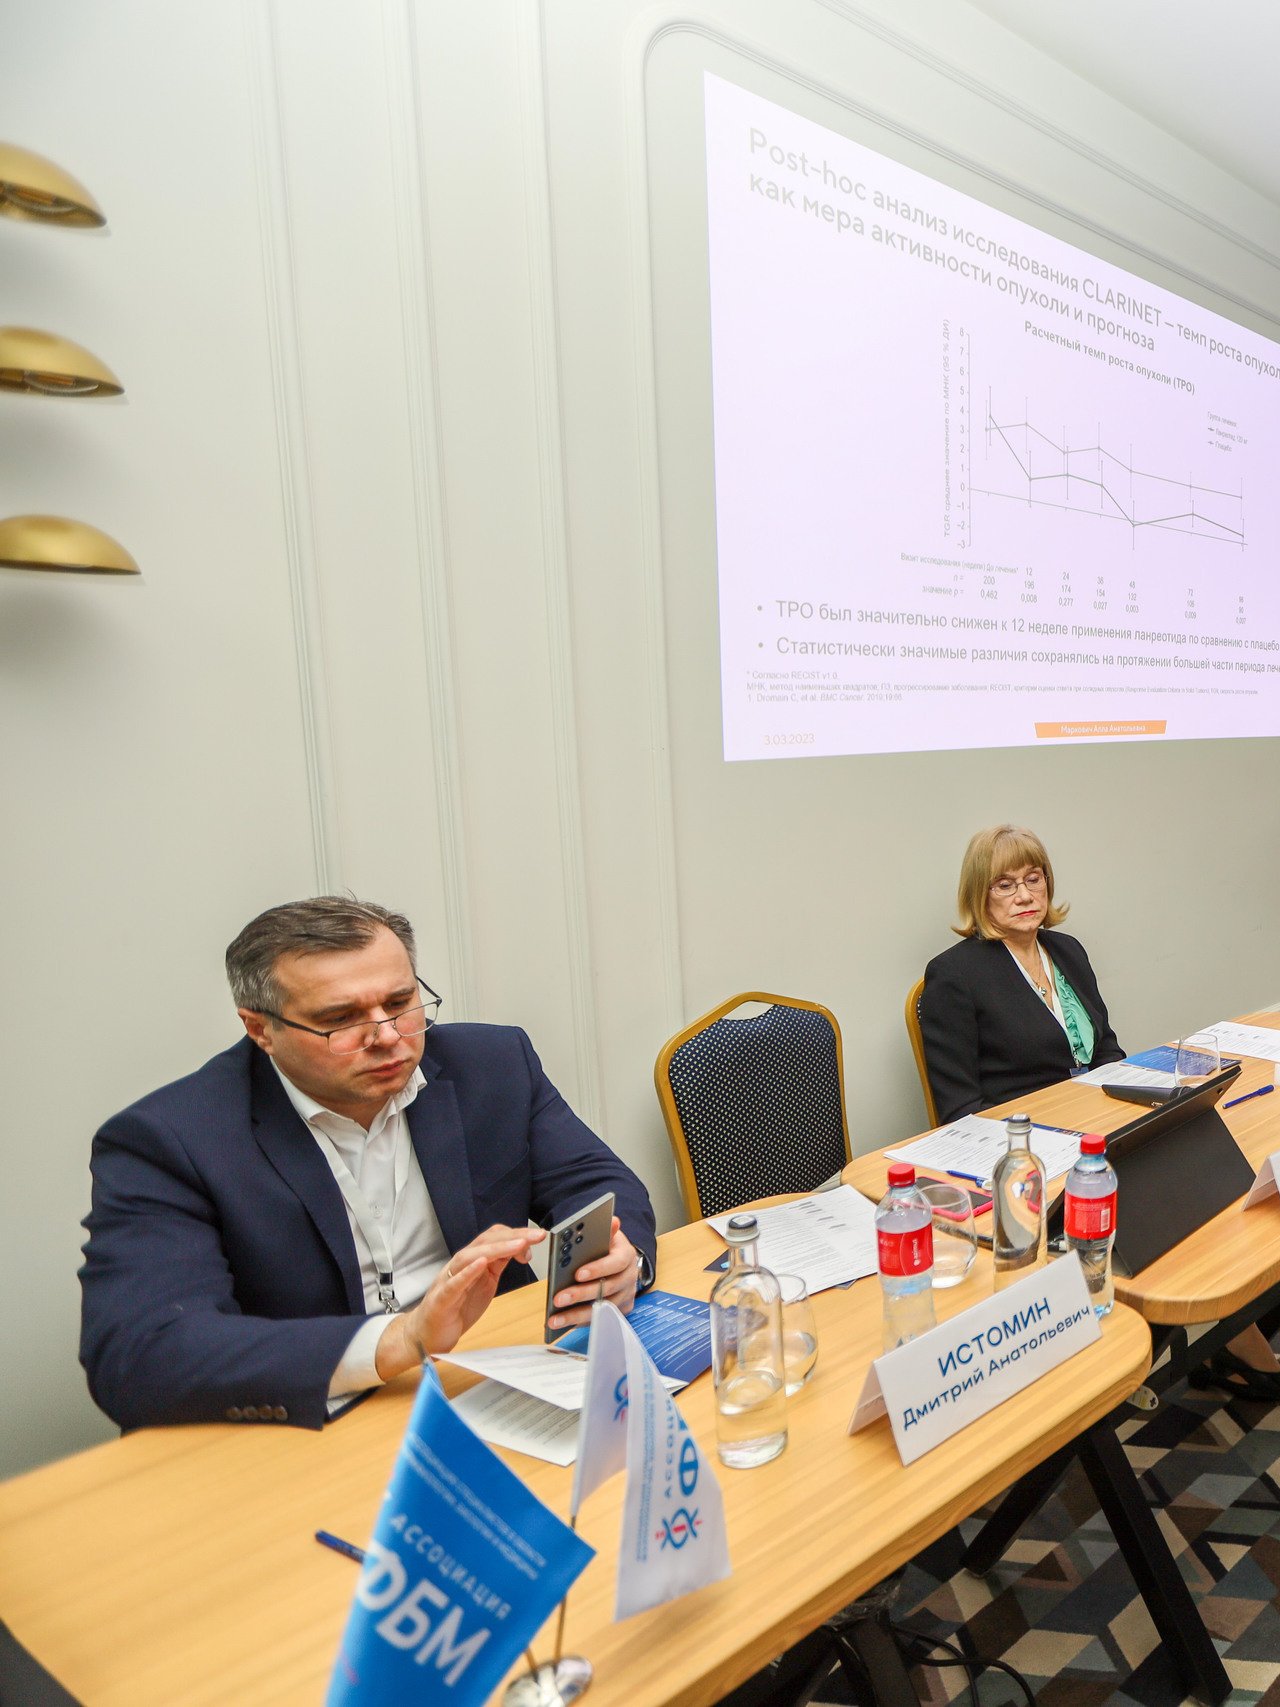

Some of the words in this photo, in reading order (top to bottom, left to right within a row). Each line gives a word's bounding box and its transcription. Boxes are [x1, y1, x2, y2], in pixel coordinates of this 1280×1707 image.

[749, 127, 867, 201] Post-hoc
[873, 190, 948, 236] анализ
[953, 224, 1078, 292] исследования
[1083, 278, 1162, 327] CLARINET
[1177, 323, 1207, 348] темп
[1209, 339, 1242, 363] роста
[750, 173, 795, 208] как
[803, 195, 865, 235] мера
[871, 224, 992, 286] активности
[997, 277, 1070, 318] опухоли
[1073, 306, 1083, 324] и
[1087, 312, 1155, 352] прогноза
[1024, 320, 1081, 352] Расчетный
[1083, 344, 1106, 361] темп
[1108, 354, 1134, 373] роста
[1136, 364, 1172, 386] опухоли
[1173, 376, 1196, 396] (ТРО)
[983, 576, 995, 585] 200
[1061, 585, 1071, 594] 174
[1026, 567, 1033, 577] 12
[1062, 572, 1070, 581] 24
[775, 600, 814, 620] ТРО
[819, 603, 852, 622] был
[857, 608, 948, 628] значительно
[951, 615, 998, 631] снижен
[1001, 619, 1008, 631] к
[1012, 618, 1025, 633] 12
[1028, 621, 1068, 636] неделе
[1071, 625, 1132, 640] применения
[1134, 630, 1187, 646] ланреотида
[1189, 634, 1199, 645] по
[1200, 635, 1243, 650] сравнению
[1244, 639, 1249, 649] с
[776, 636, 896, 658] Статистически
[899, 645, 968, 660] значимые
[971, 648, 1028, 663] различия
[1031, 650, 1100, 666] сохранялись
[1102, 654, 1114, 666] на
[1116, 655, 1171, 669] протяжении
[1173, 656, 1210, 670] большей
[1211, 660, 1234, 671] части
[1235, 663, 1265, 674] периода
[791, 671, 820, 680] RECIST
[763, 733, 816, 746] 3.03.2023
[1061, 724, 1093, 735] Маркович
[1094, 724, 1109, 734] Алла
[938, 1297, 1051, 1378] ИСТОМИН
[903, 1368, 985, 1431] Дмитрий
[988, 1306, 1091, 1377] Анатольевич
[389, 1513, 512, 1620] АССОЦИАЦИЯ
